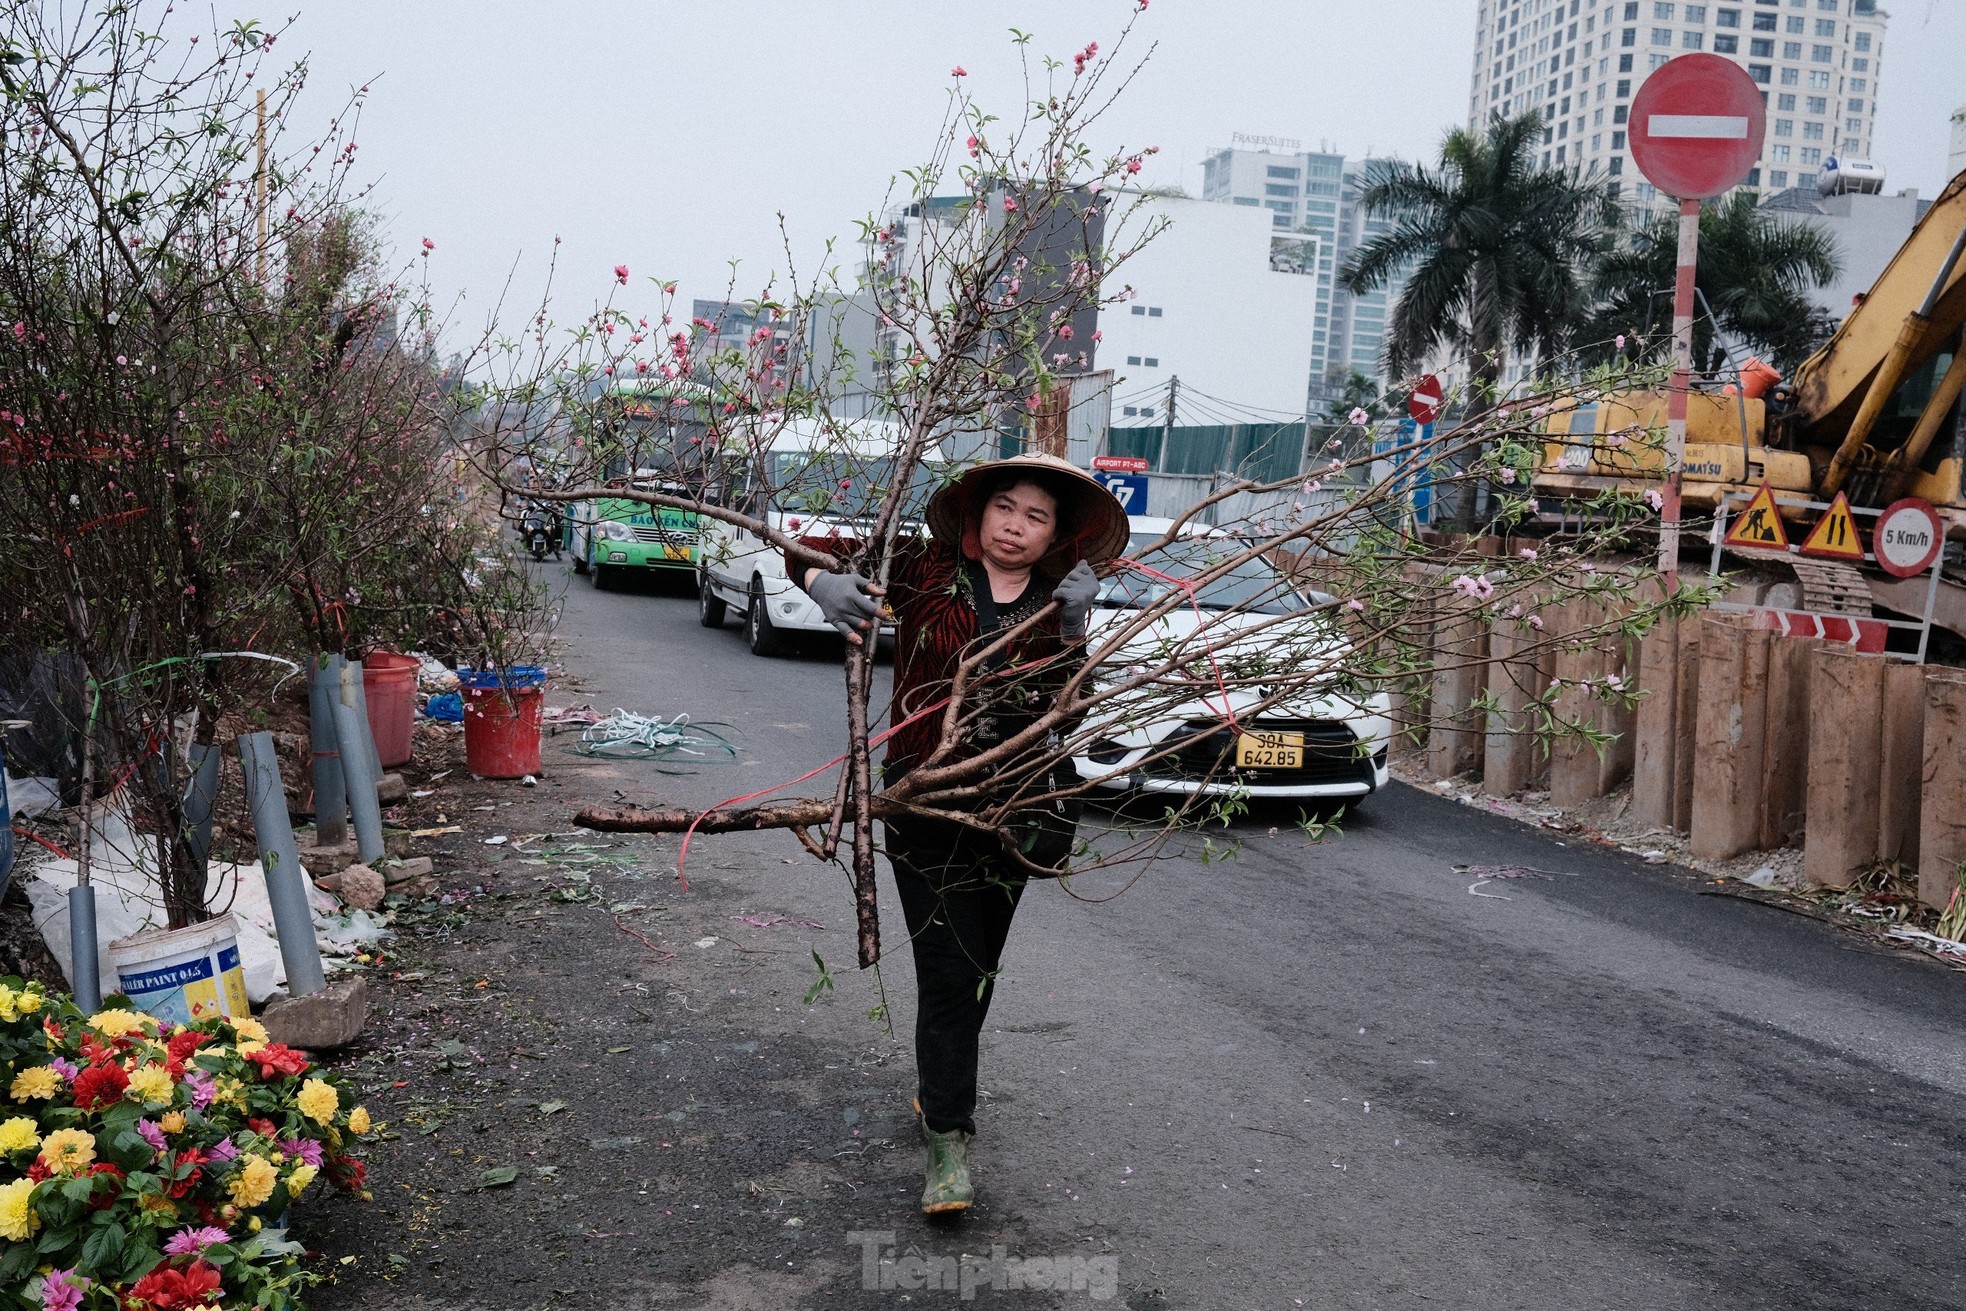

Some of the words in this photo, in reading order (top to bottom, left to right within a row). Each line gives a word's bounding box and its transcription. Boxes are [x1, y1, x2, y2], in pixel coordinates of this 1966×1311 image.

[1096, 459, 1121, 467] AIRPORT
[1681, 461, 1722, 475] OMATSU
[1886, 530, 1893, 544] 5
[1897, 530, 1928, 546] Km/h
[1244, 750, 1296, 766] 642.85
[145, 972, 177, 988] PAINT
